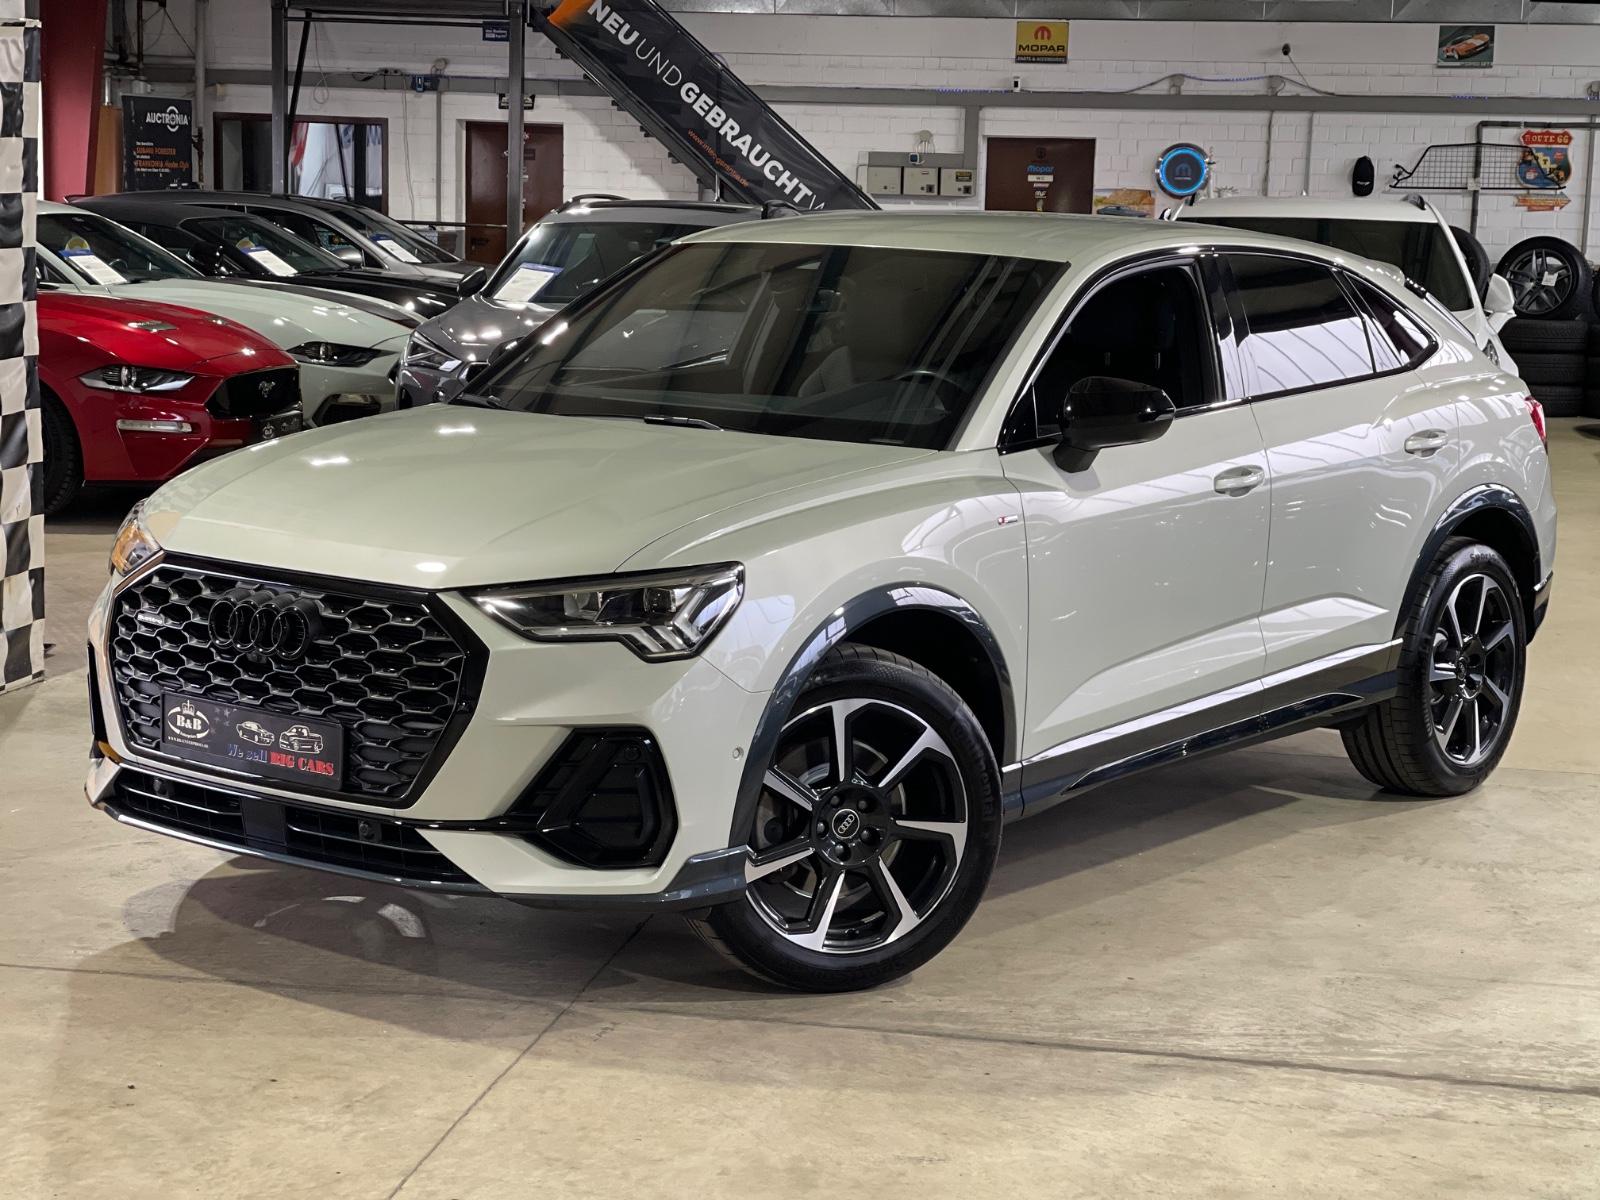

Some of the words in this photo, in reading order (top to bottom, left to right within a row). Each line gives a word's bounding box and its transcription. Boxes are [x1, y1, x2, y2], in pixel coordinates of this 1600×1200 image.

[587, 0, 640, 45] NEU
[636, 38, 682, 86] UND
[1018, 44, 1066, 53] MOPAR
[146, 111, 189, 127] AUCTRONIA
[1524, 134, 1556, 142] ROUTE
[1557, 134, 1569, 144] 66
[176, 714, 202, 731] B&B
[226, 743, 244, 758] We
[246, 749, 268, 763] sell
[270, 752, 295, 768] BIG
[297, 757, 335, 776] CARS
